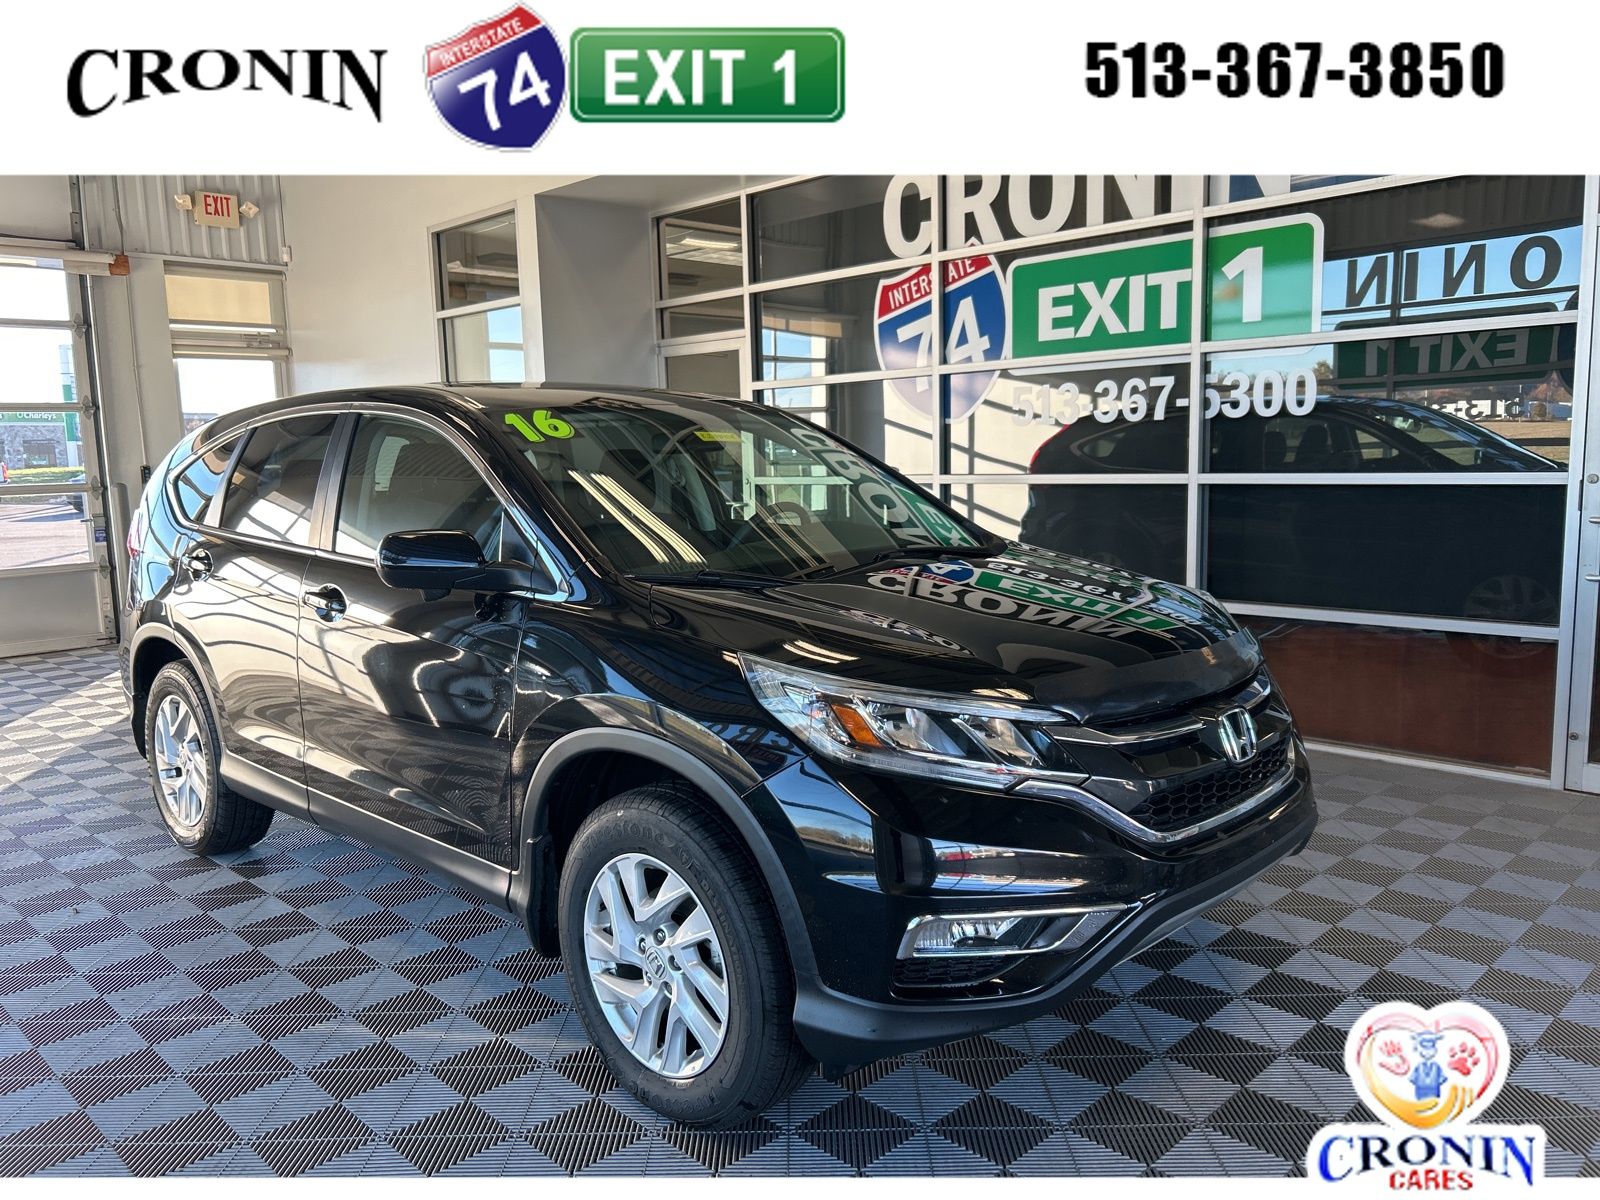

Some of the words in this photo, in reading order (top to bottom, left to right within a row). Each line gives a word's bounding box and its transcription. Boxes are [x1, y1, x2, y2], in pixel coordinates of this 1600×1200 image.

[203, 194, 231, 218] EXIT
[883, 174, 1290, 259] CRO
[887, 257, 977, 310] INTERATE
[1038, 268, 1193, 342] EXIT
[1220, 246, 1264, 323] 1
[896, 295, 991, 393] 74
[504, 409, 575, 443] 16
